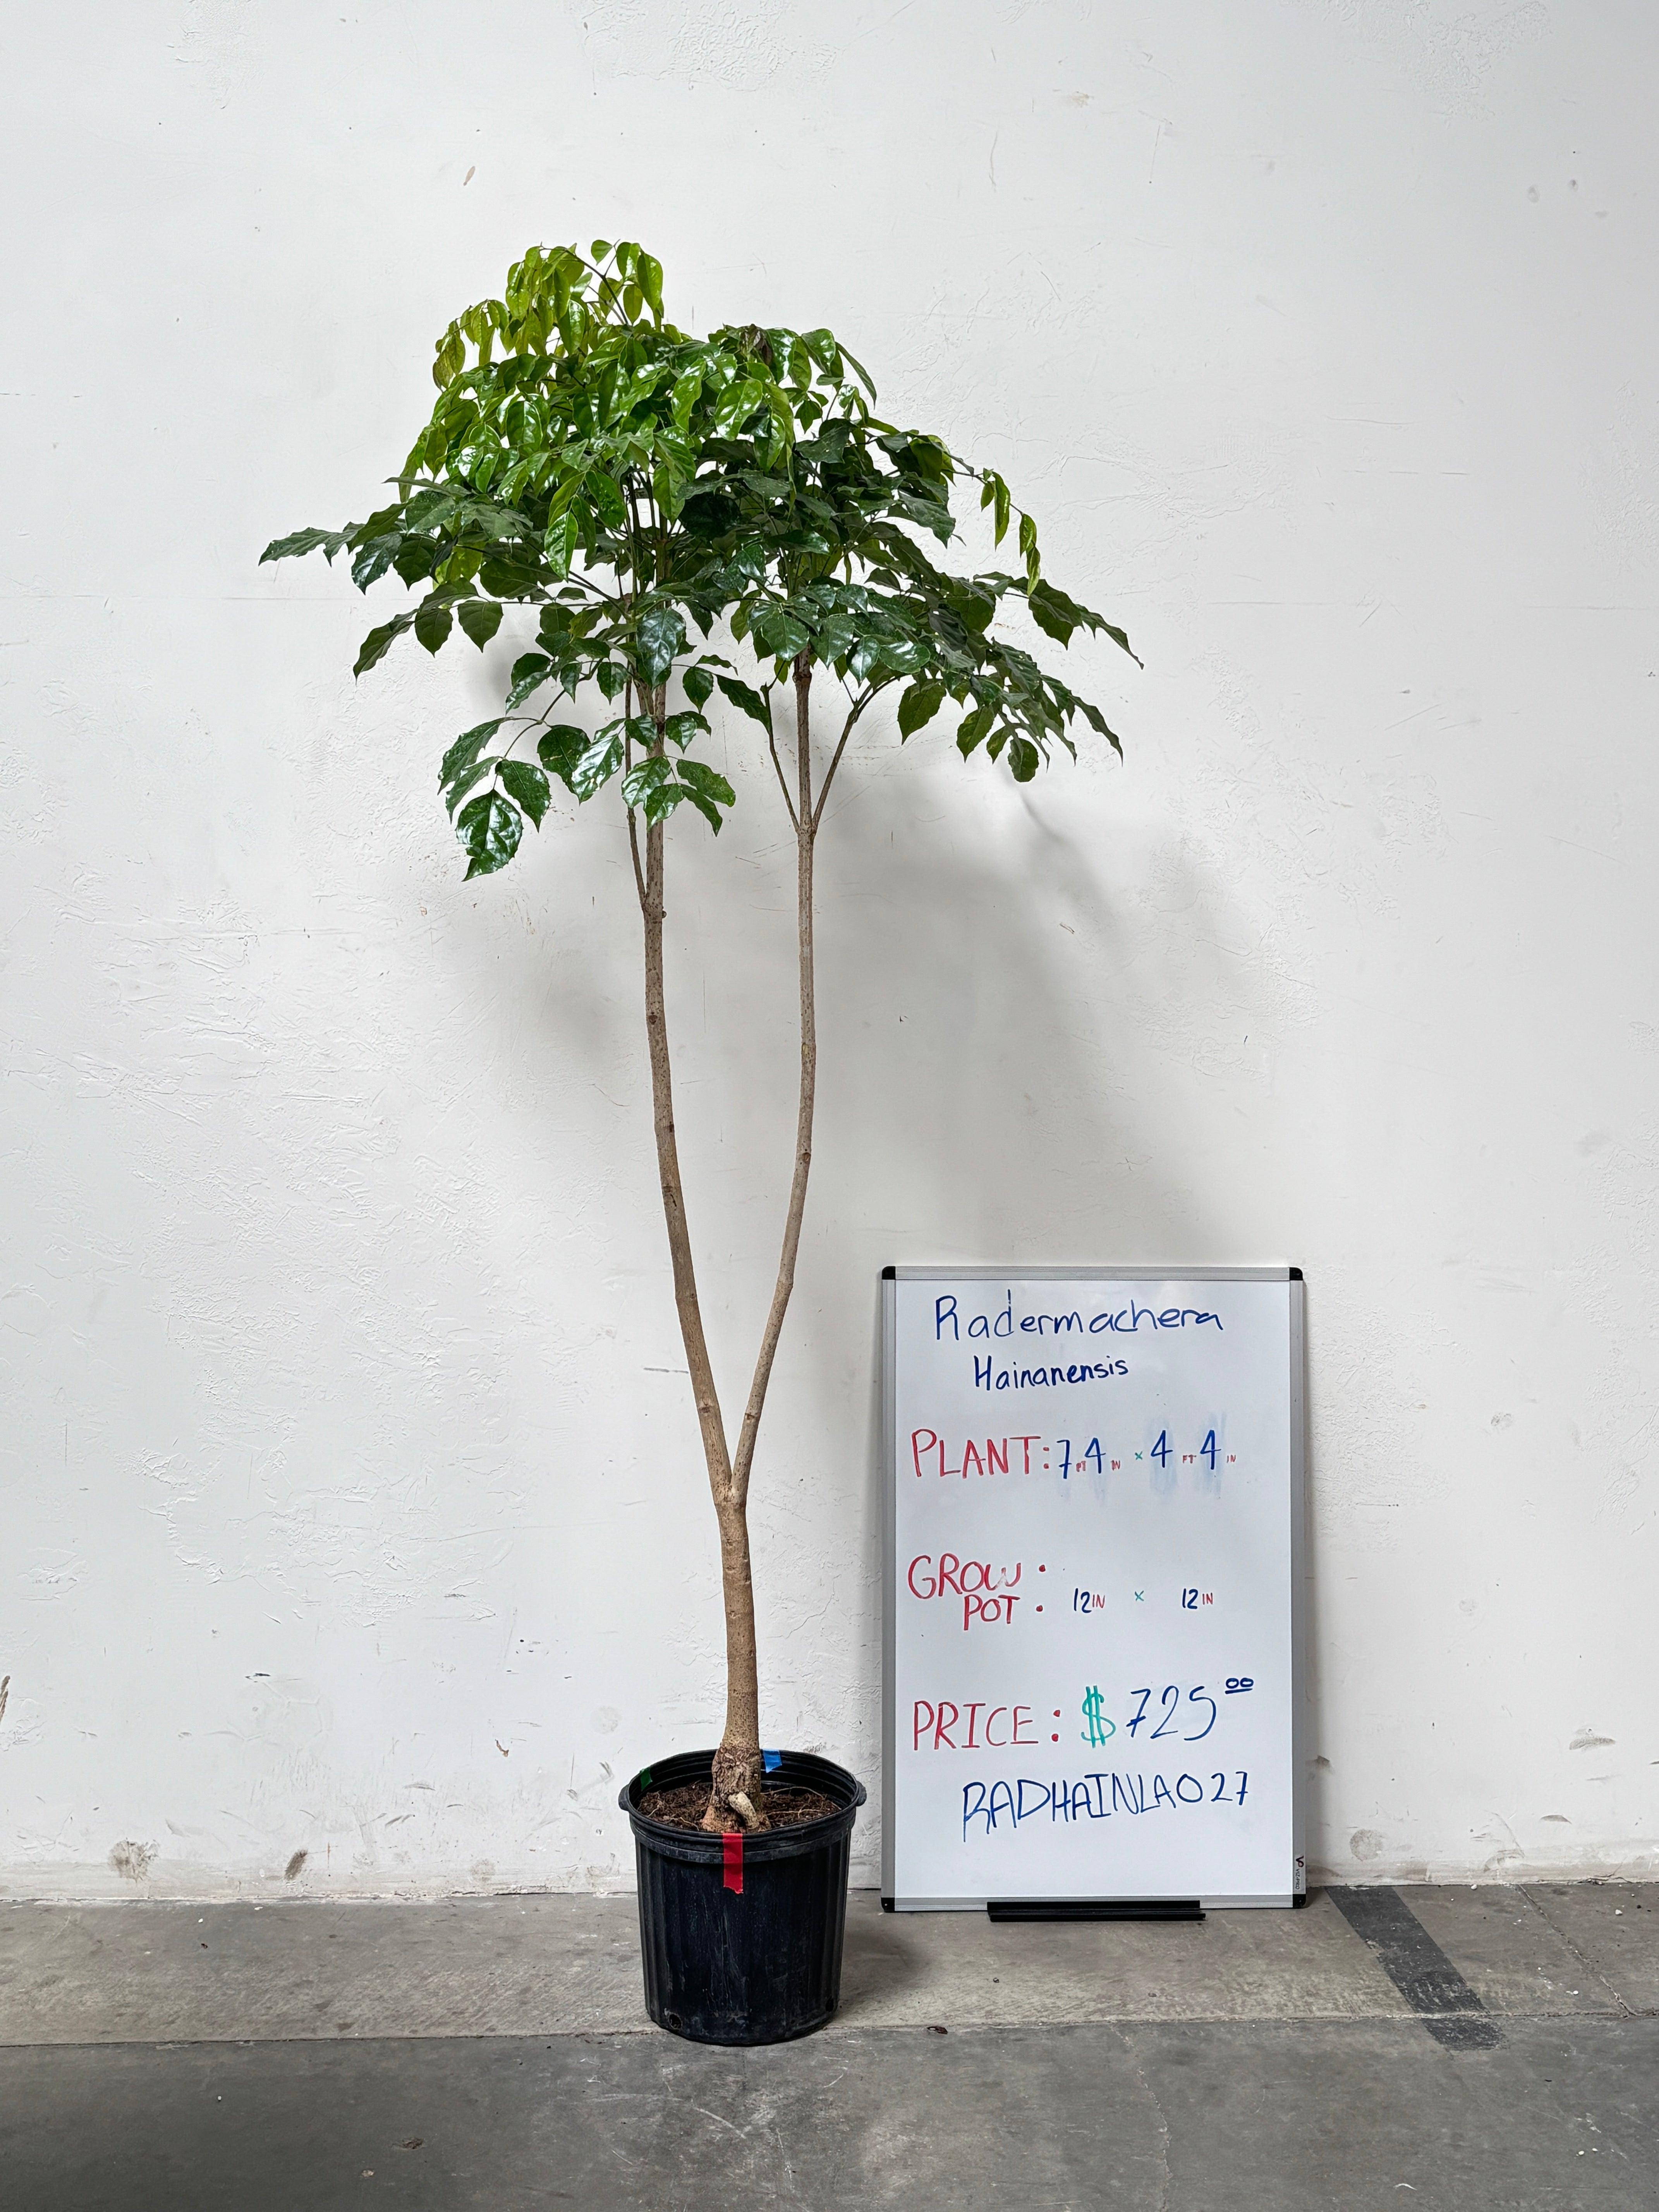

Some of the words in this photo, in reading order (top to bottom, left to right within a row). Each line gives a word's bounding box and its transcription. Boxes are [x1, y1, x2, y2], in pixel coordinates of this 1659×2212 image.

[935, 1289, 1224, 1341] Radermachera
[973, 1355, 1129, 1391] Hainanensis
[911, 1429, 1049, 1479] PLANT:
[1150, 1429, 1173, 1468] 4
[1199, 1429, 1222, 1470] 4
